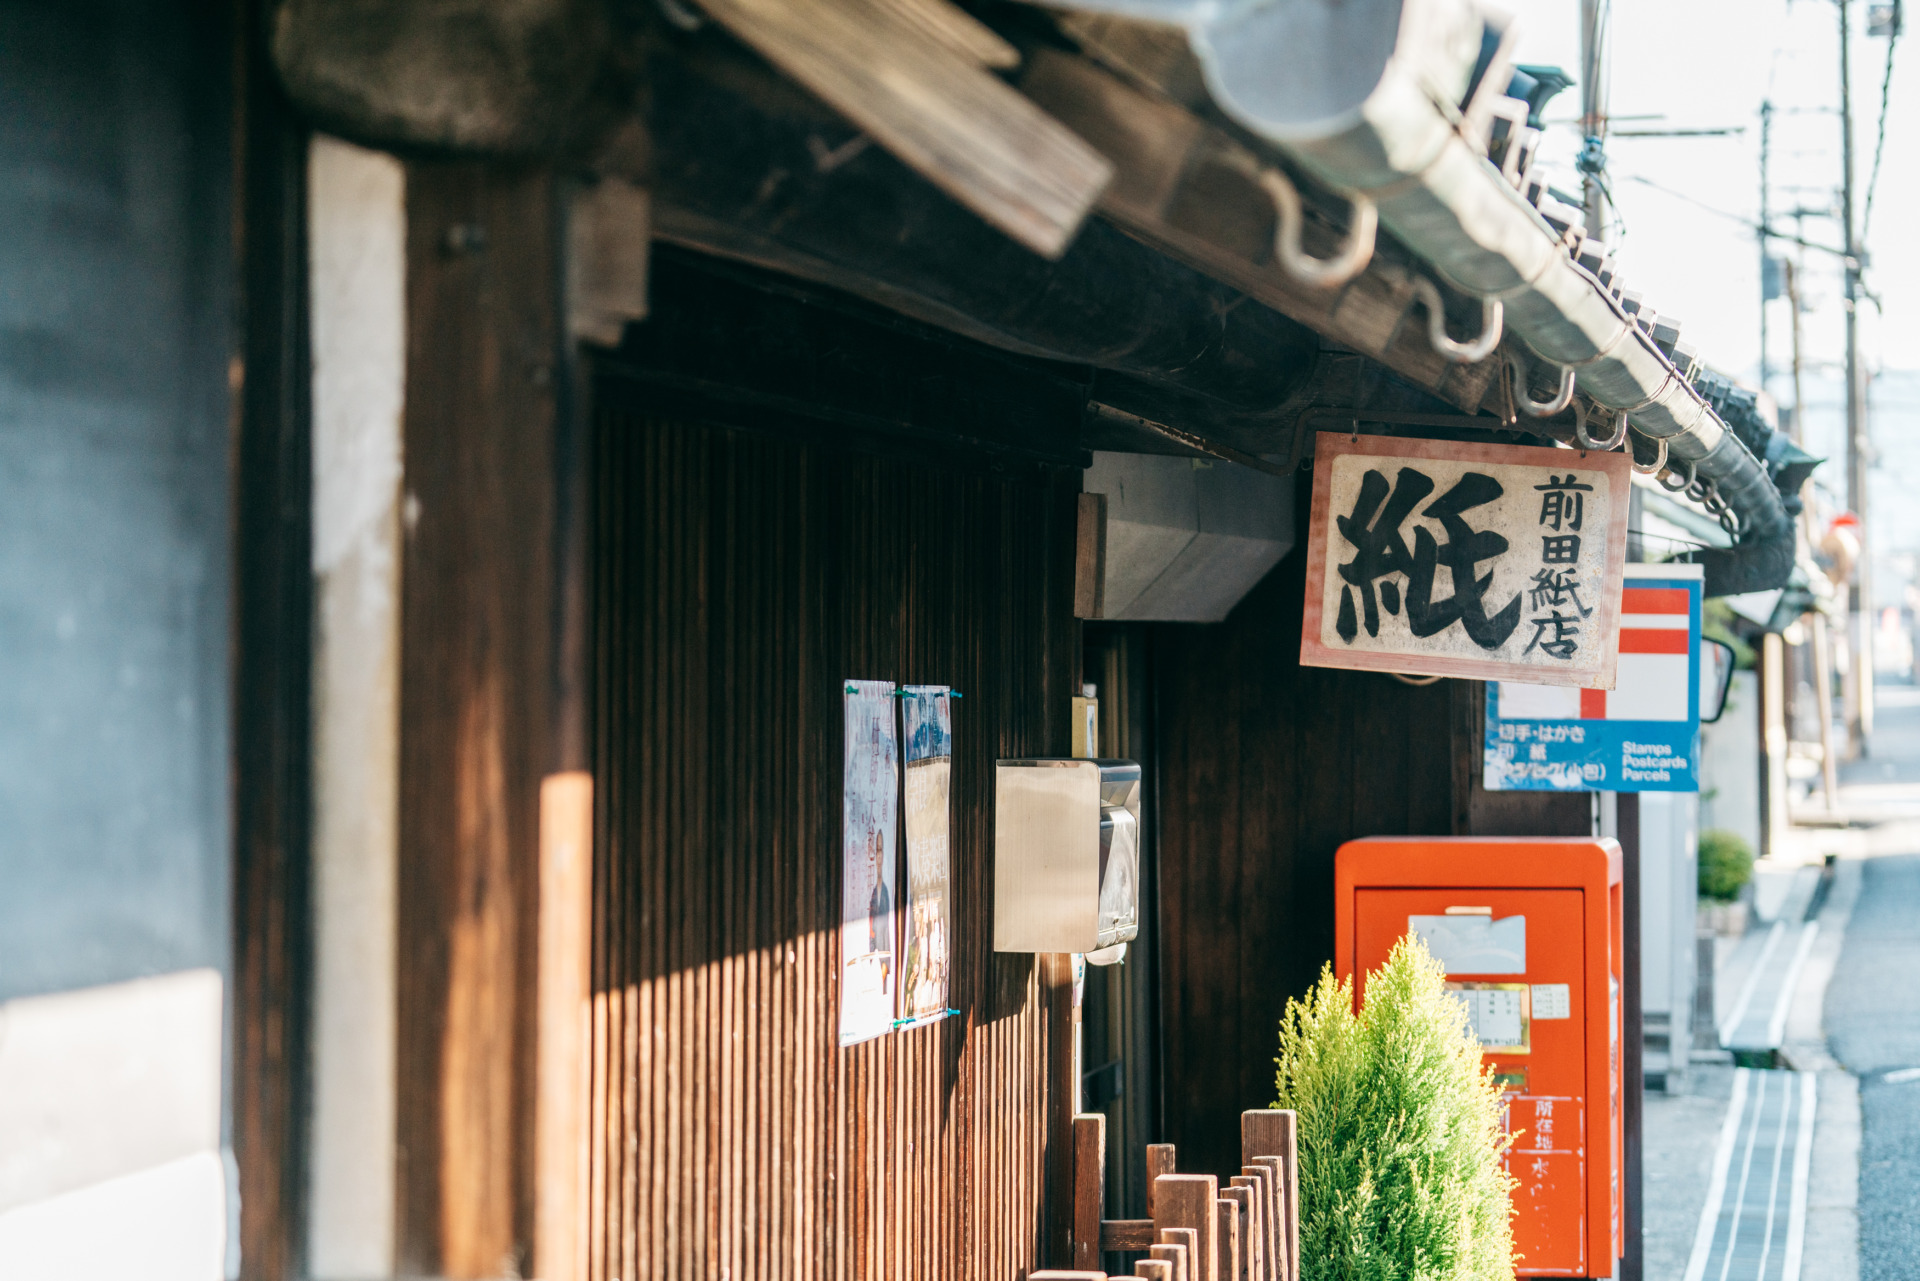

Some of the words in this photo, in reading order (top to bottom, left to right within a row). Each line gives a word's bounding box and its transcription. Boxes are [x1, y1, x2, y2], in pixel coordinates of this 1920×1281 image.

[1336, 466, 1522, 650] 紙
[1522, 473, 1594, 660] 前田紙店
[1622, 740, 1672, 758] Stamps
[1622, 754, 1688, 770] Postcards
[1622, 767, 1671, 782] Parcels
[1534, 1100, 1554, 1150] 所在地
